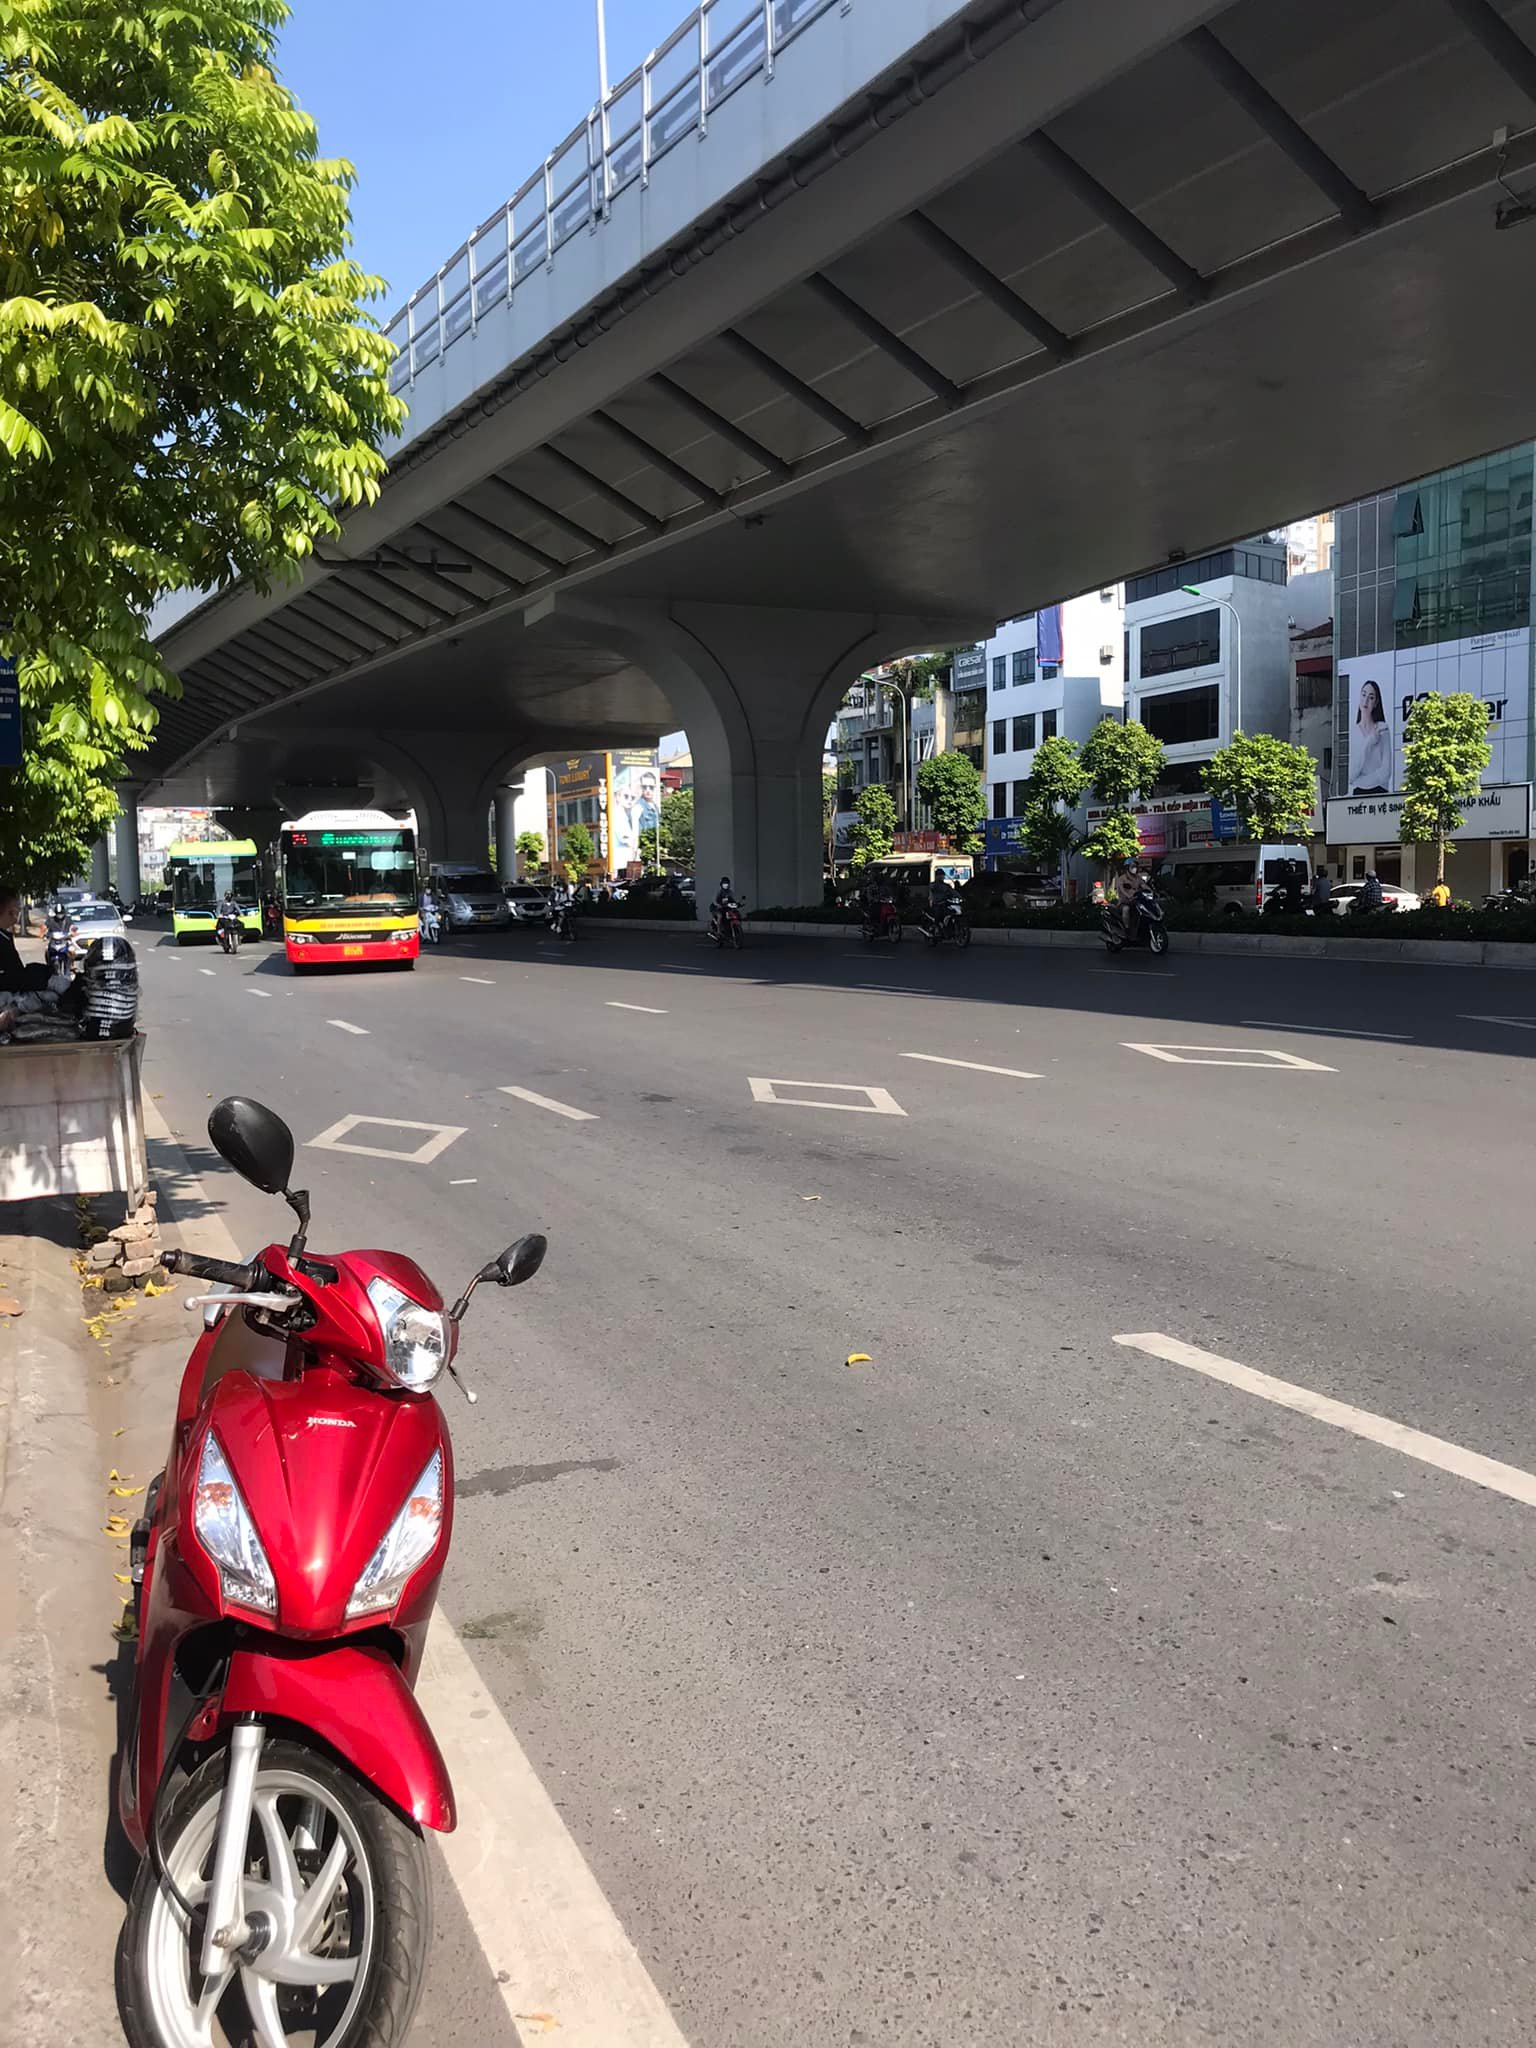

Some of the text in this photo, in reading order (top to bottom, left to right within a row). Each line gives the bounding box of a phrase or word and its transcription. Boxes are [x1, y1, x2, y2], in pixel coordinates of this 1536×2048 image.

[1153, 801, 1166, 813] TRẢ
[1347, 801, 1368, 815] THIẾT
[1369, 803, 1376, 816] BỊ
[1378, 801, 1387, 815] VỆ
[306, 1416, 357, 1428] HONDA
